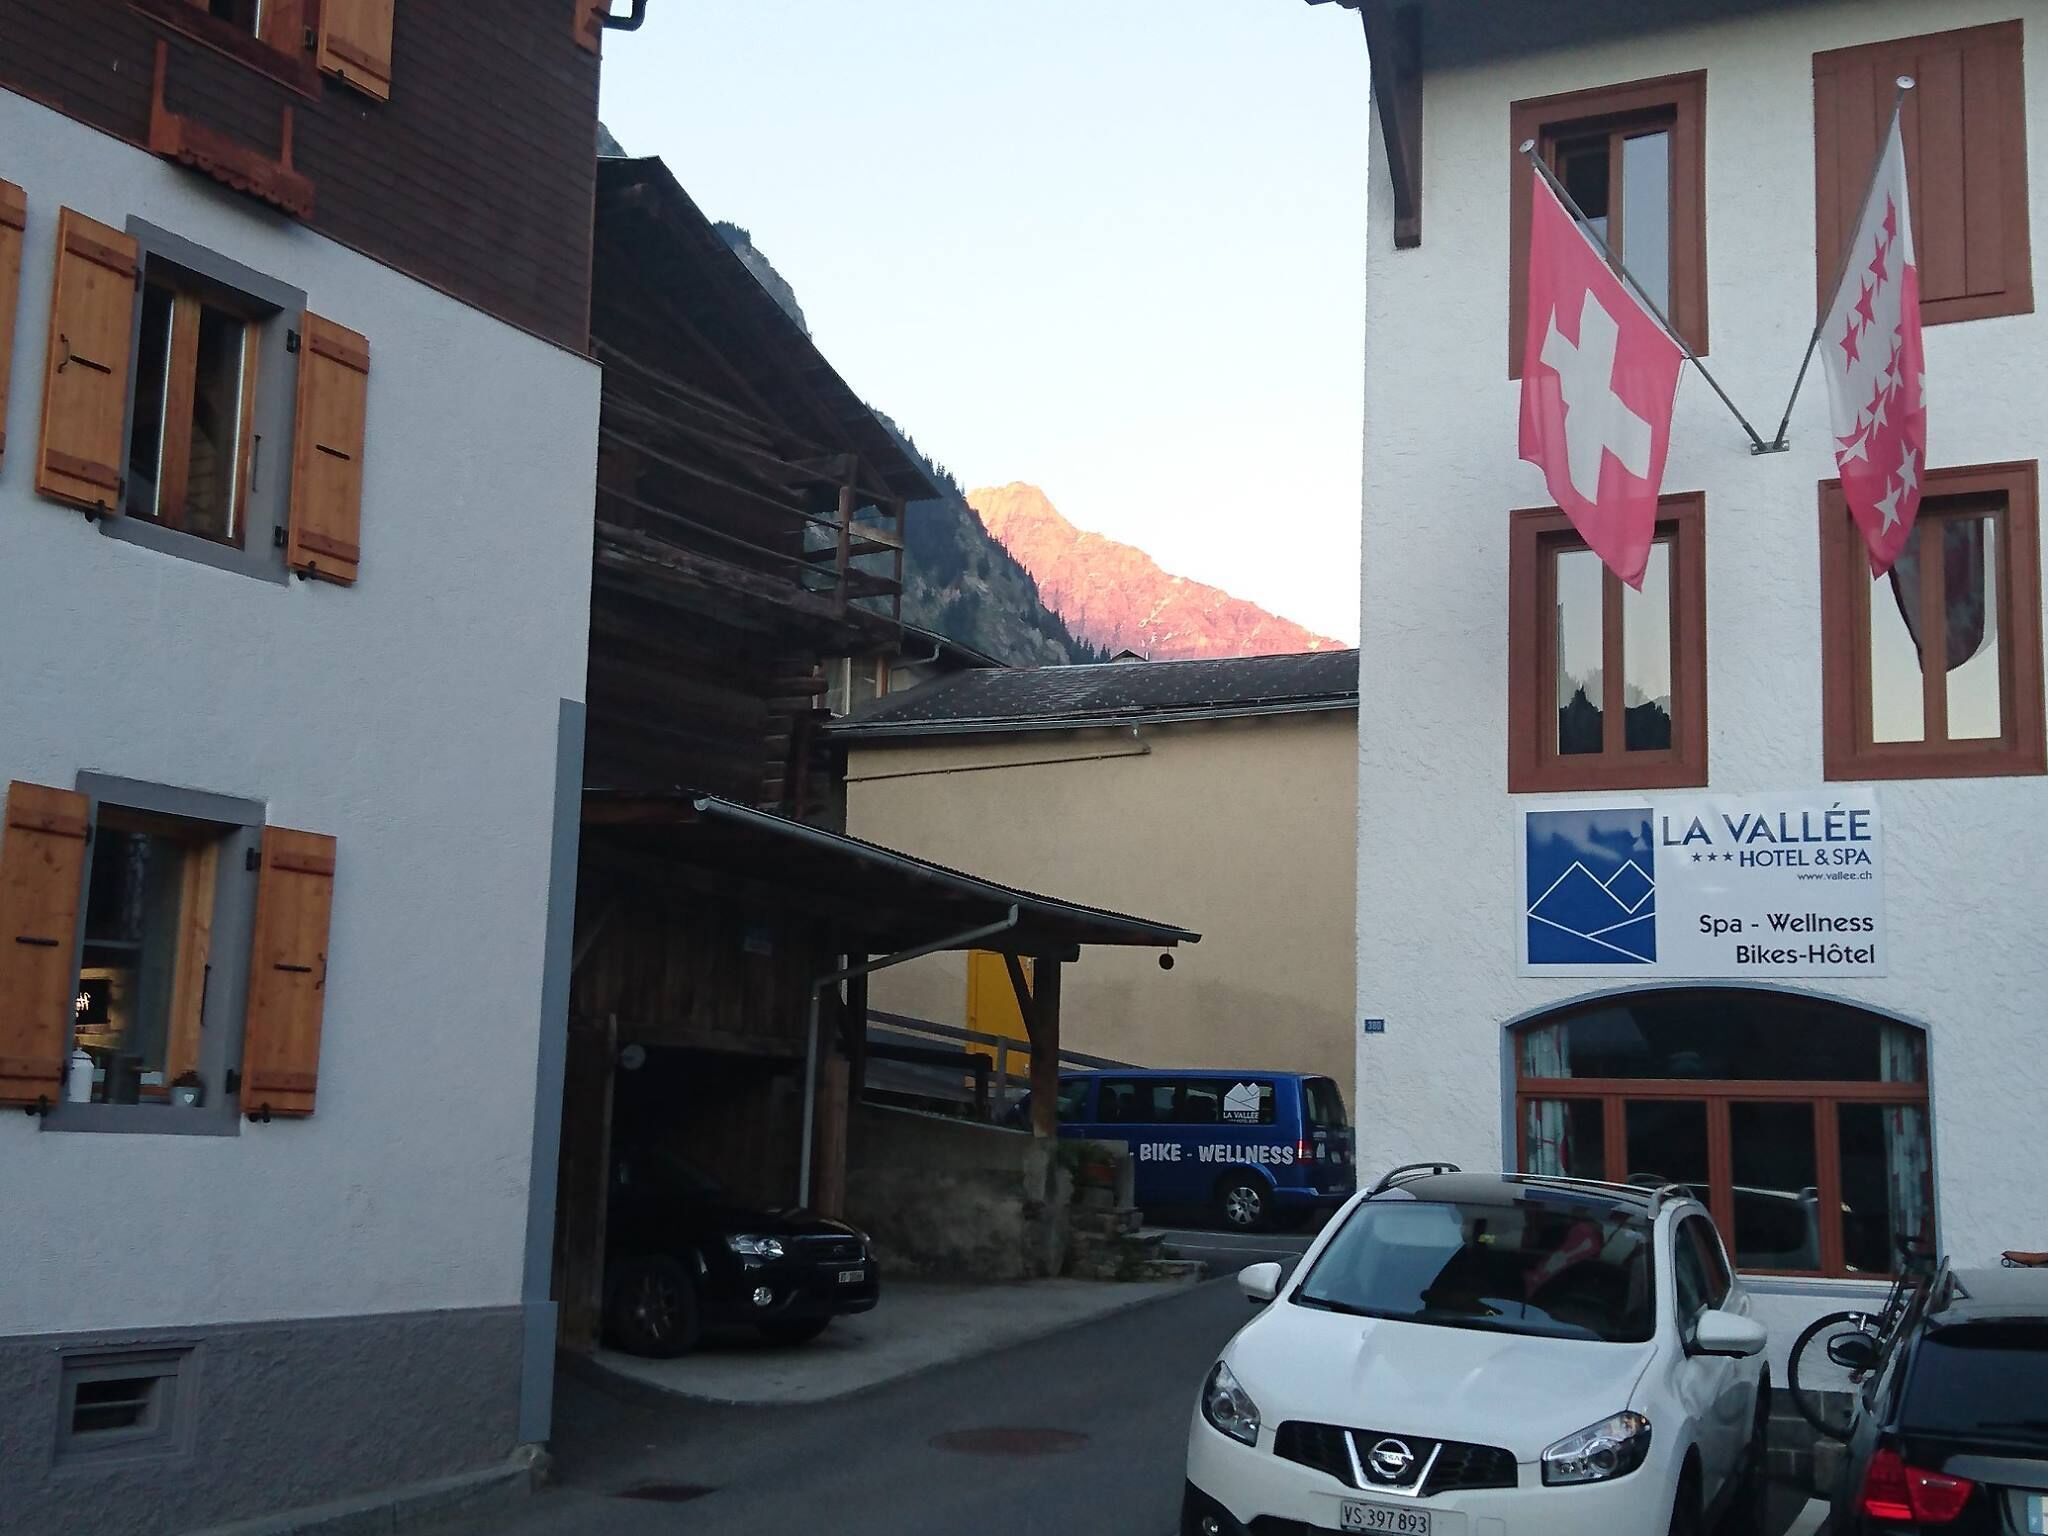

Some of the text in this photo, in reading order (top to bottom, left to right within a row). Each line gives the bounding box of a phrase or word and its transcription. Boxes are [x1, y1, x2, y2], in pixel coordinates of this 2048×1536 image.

[1662, 802, 1872, 846] LA VALLÉE
[1739, 850, 1810, 867] HOTEL
[1832, 848, 1873, 866] SPA
[1797, 870, 1873, 881] www.vallee.ch
[1699, 914, 1742, 937] Spa
[1766, 913, 1875, 932] Wellness
[1736, 943, 1875, 964] Bikes-Hôtel
[1139, 1142, 1182, 1162] BIKE
[1198, 1144, 1294, 1165] WELLNESS
